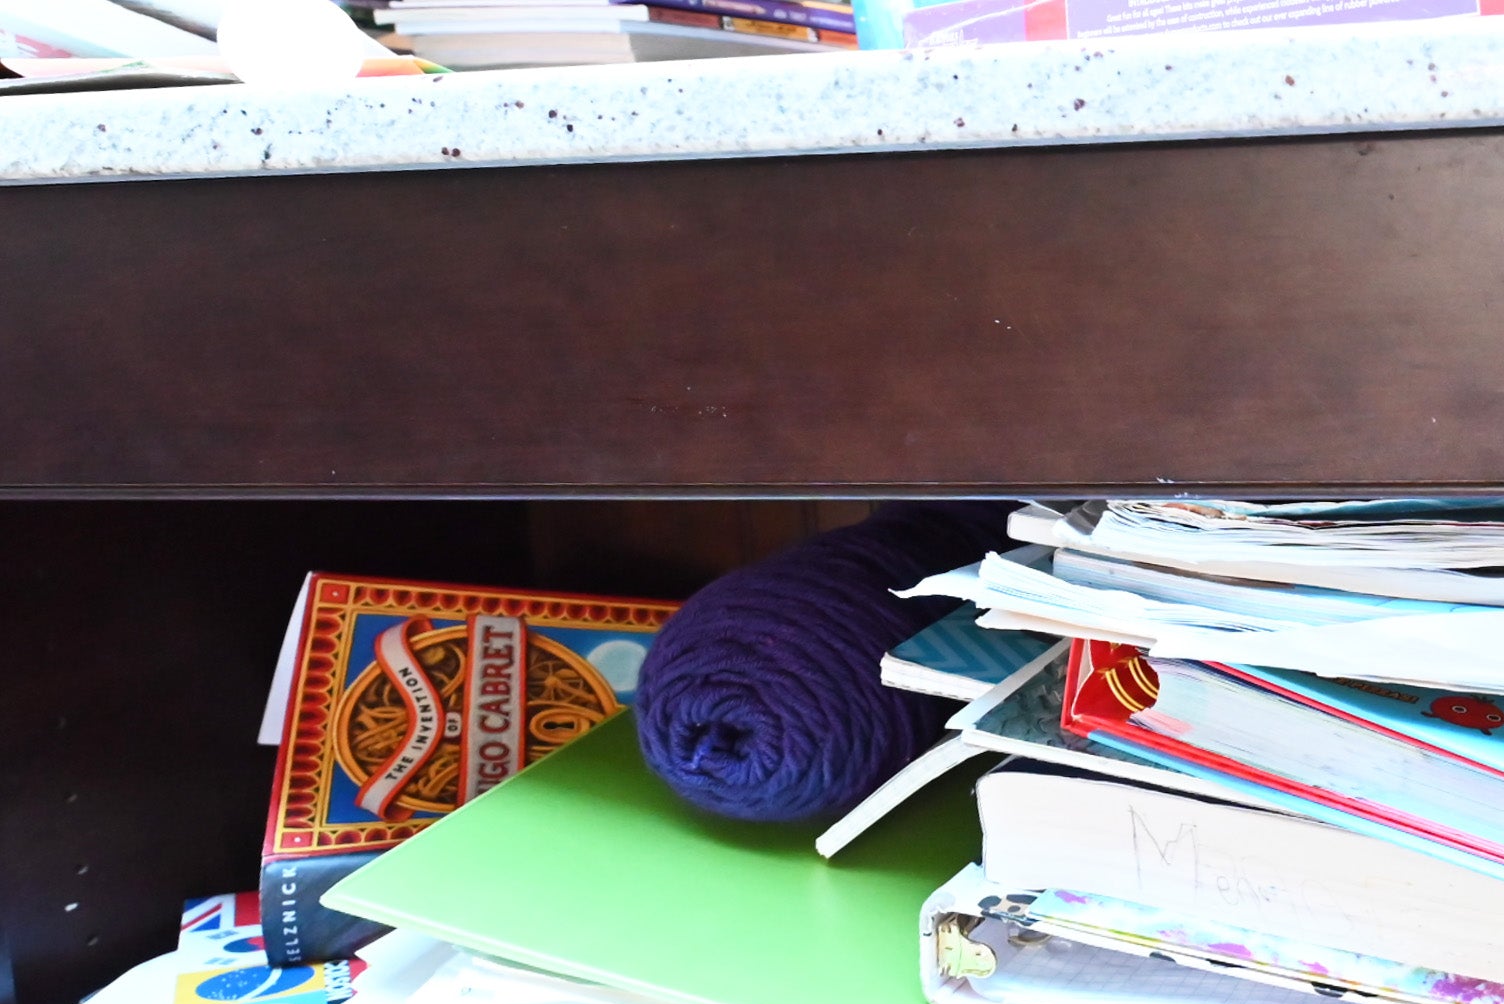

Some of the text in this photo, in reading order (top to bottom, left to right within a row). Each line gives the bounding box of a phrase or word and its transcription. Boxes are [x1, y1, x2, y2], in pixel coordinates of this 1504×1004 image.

[385, 667, 433, 780] THE INVENTION
[447, 719, 458, 731] OF
[480, 626, 514, 733] CABRET
[282, 867, 302, 961] SELZNICK
